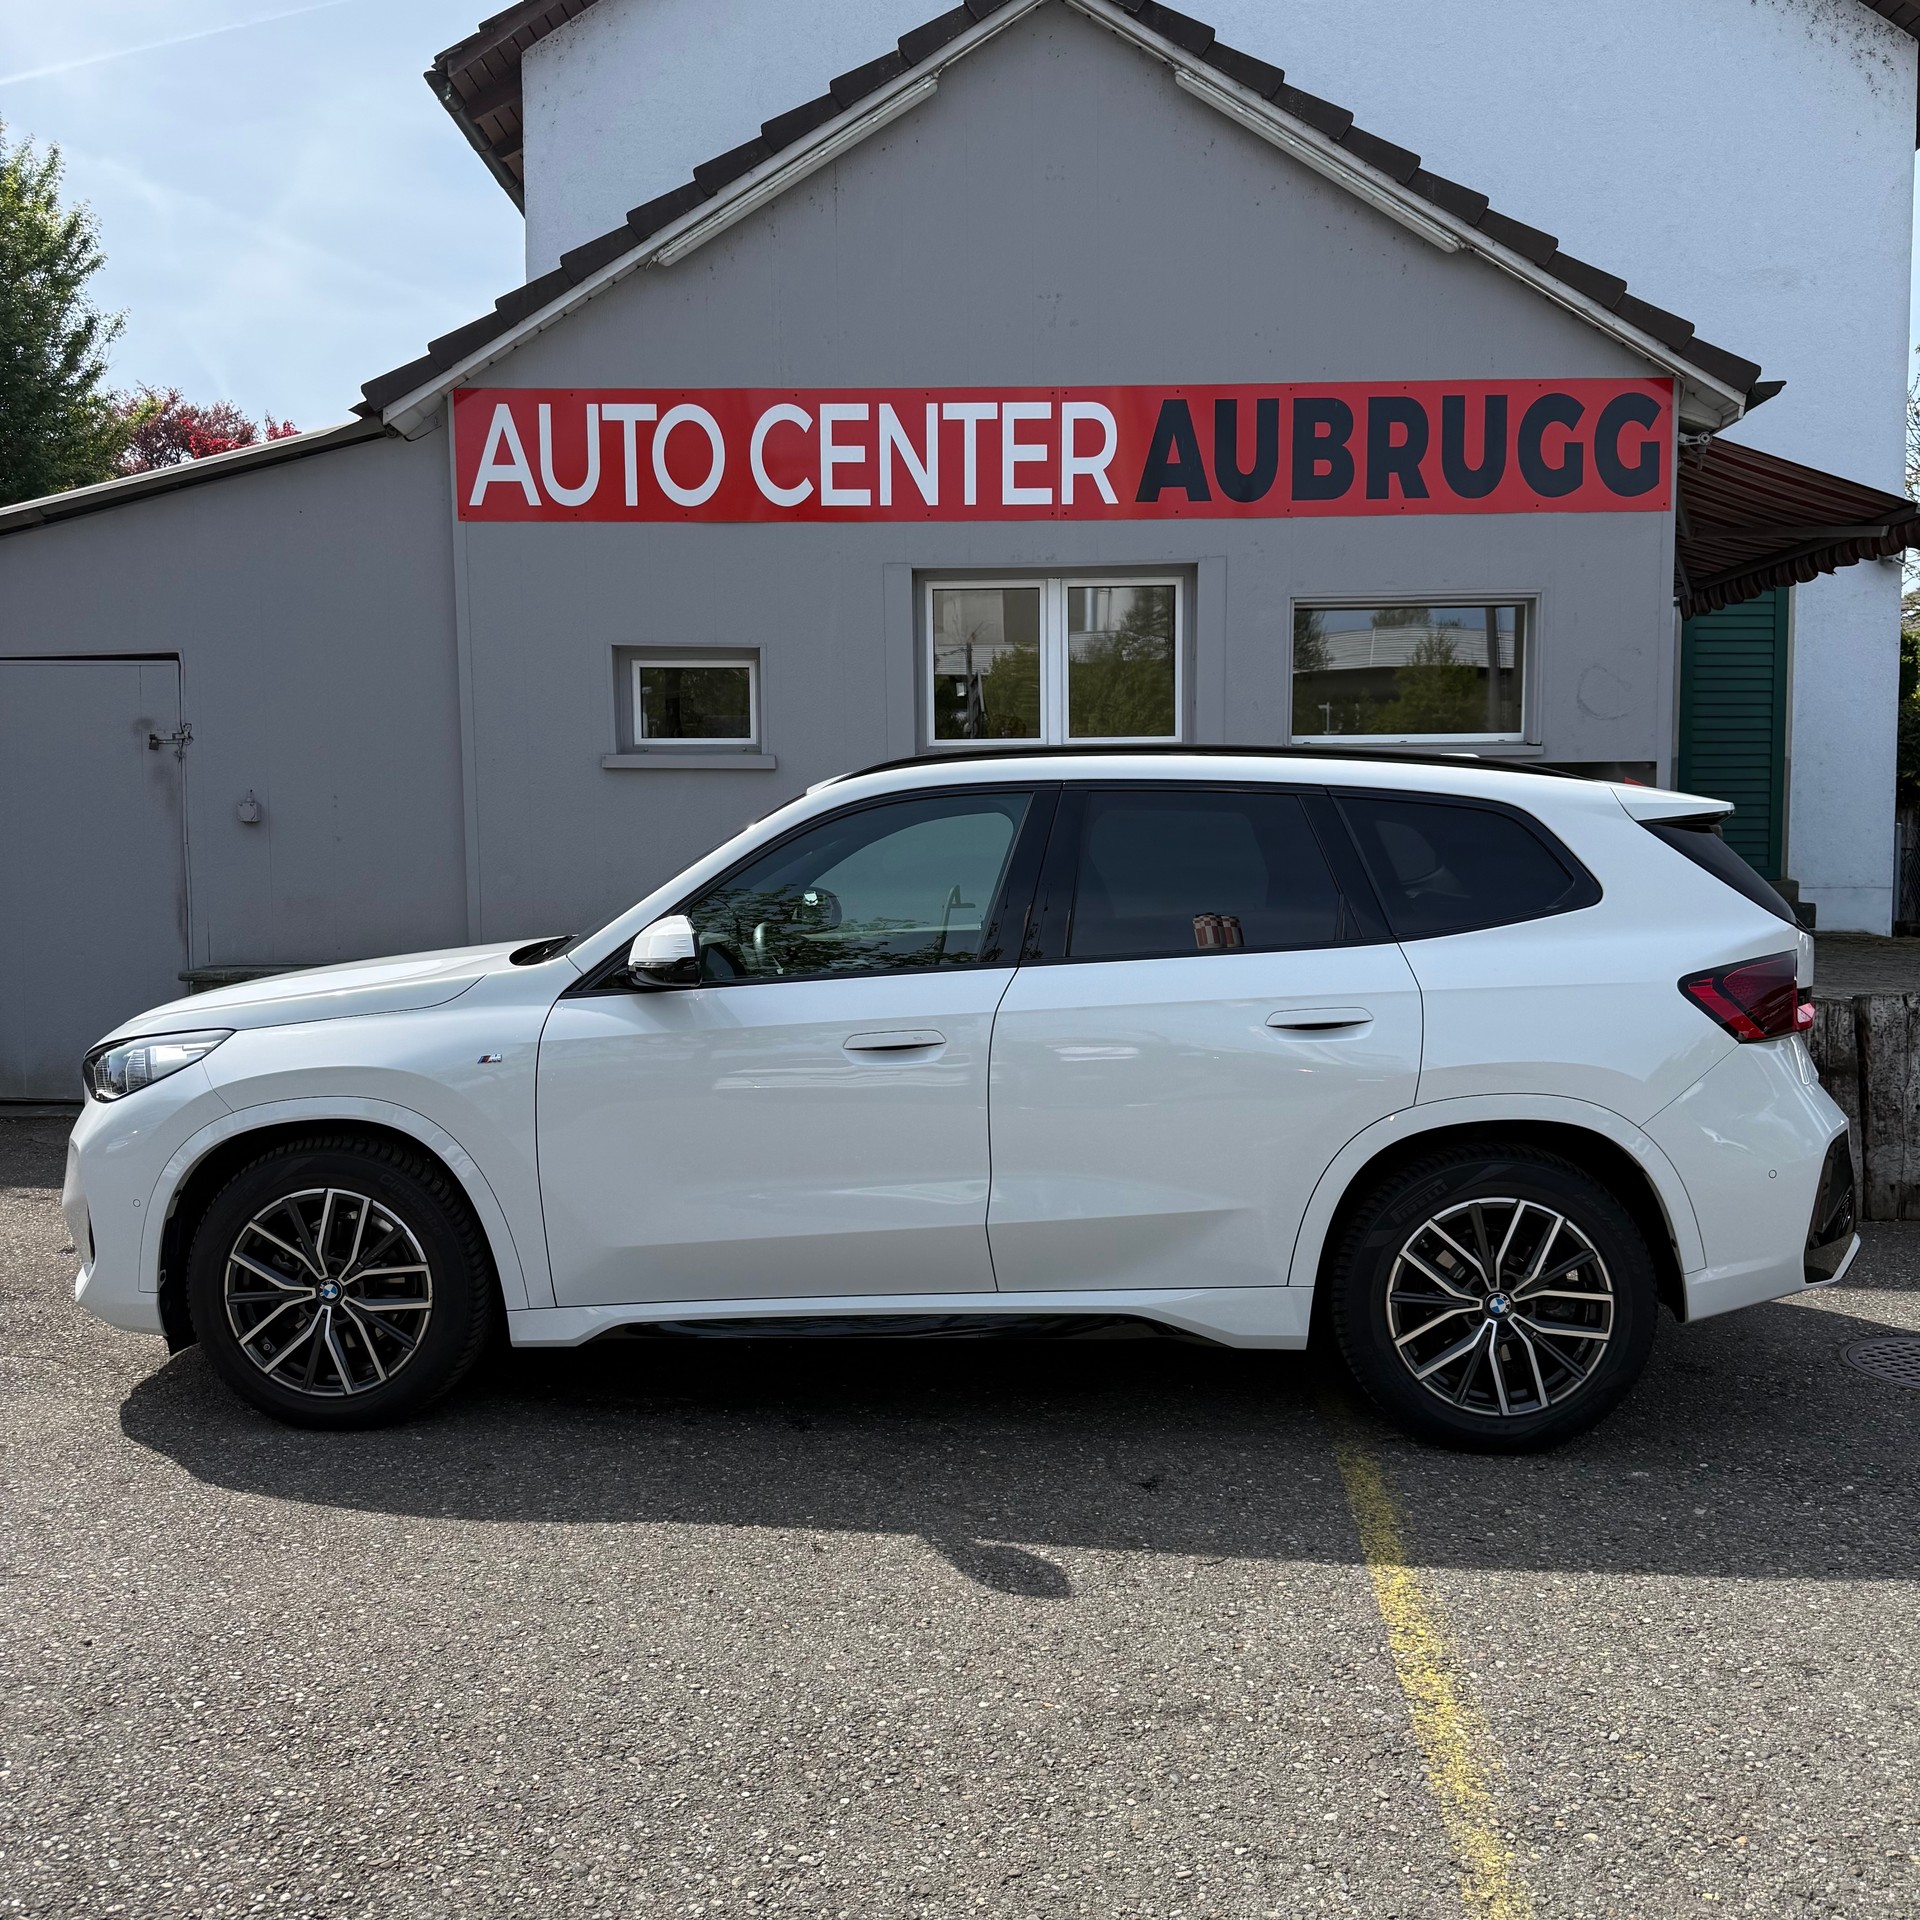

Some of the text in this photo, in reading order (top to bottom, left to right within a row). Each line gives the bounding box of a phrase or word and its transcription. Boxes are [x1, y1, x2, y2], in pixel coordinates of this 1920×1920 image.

[469, 392, 1662, 507] AUTO CENTER AUBRUGG
